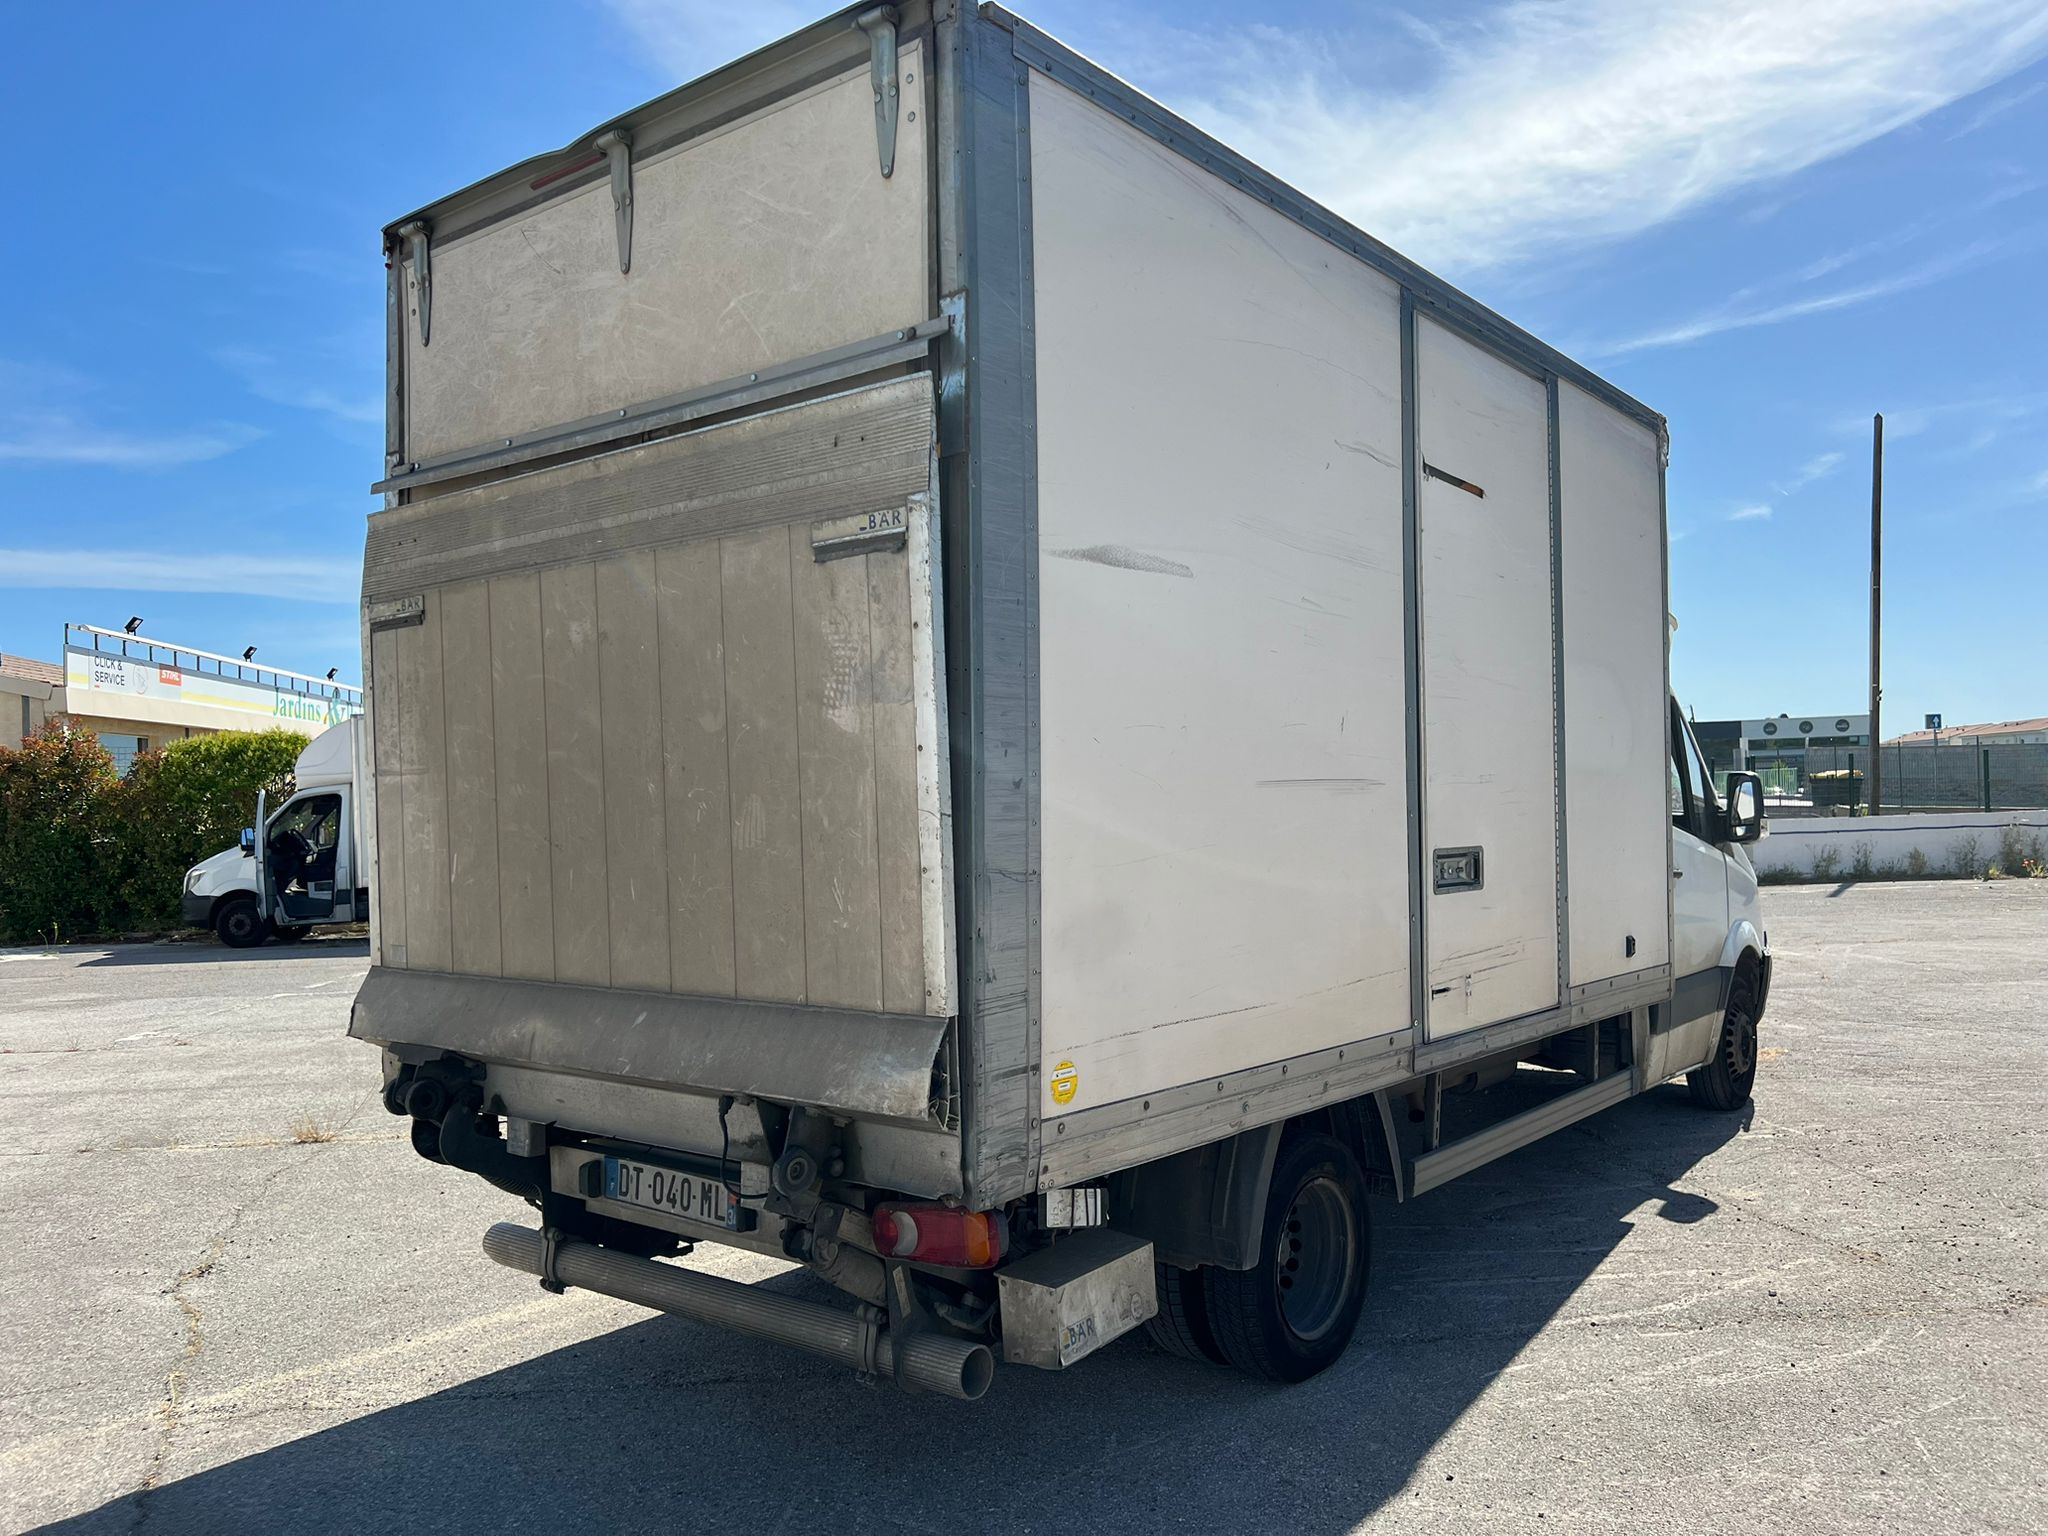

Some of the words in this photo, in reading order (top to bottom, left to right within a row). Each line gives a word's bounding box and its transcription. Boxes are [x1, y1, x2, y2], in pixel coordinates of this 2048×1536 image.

[868, 509, 901, 530] BÄR
[94, 655, 116, 670] CLICK
[117, 659, 123, 671] &
[94, 670, 125, 686] SERVICE
[161, 669, 180, 681] STIHL
[273, 687, 321, 722] Jardins
[1069, 1318, 1094, 1346] BÄR
